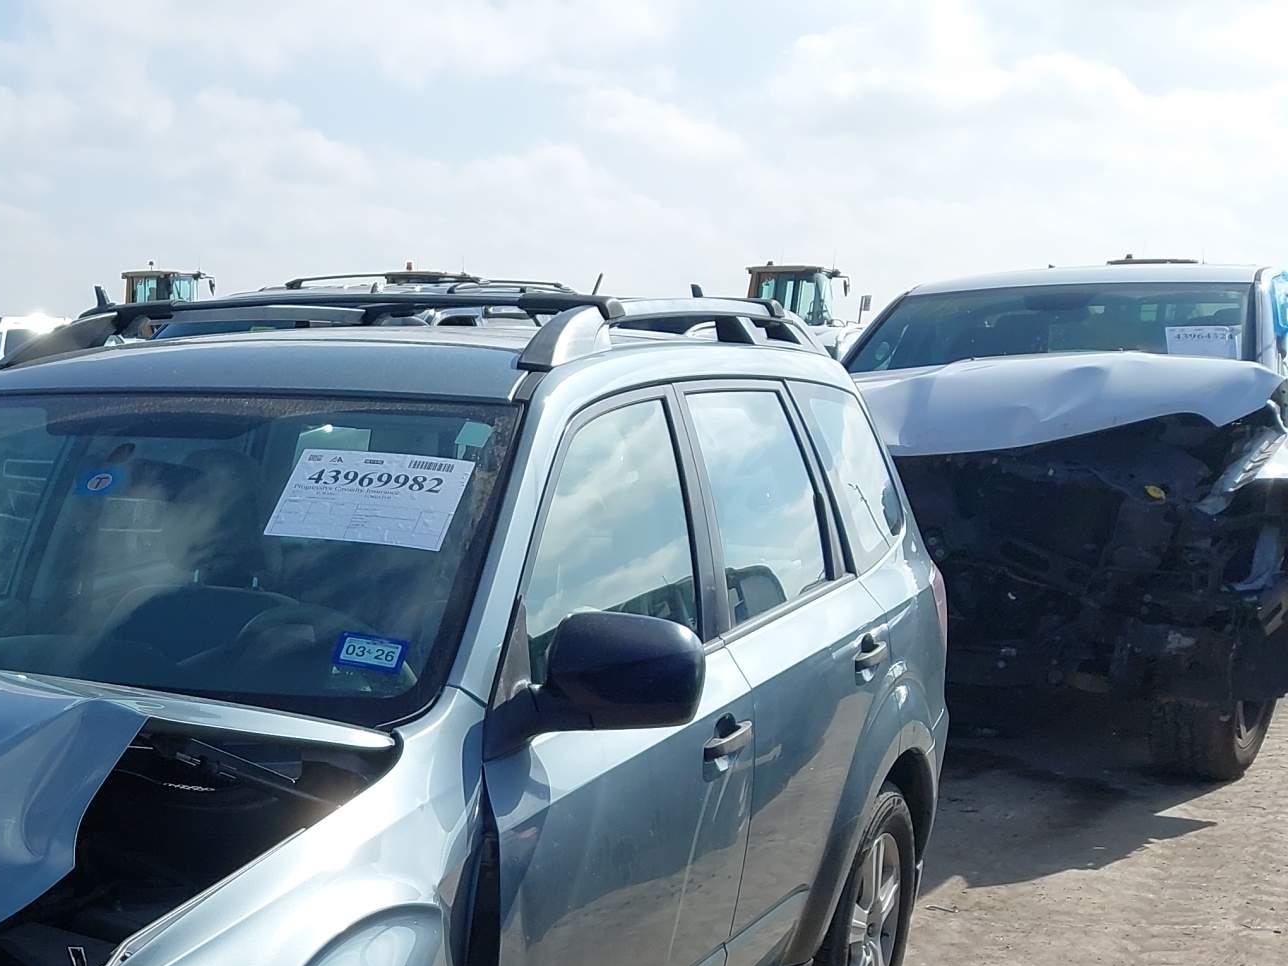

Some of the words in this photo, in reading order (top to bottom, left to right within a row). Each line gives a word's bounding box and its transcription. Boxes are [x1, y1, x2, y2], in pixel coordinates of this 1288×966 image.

[308, 468, 444, 494] 43969982
[346, 644, 367, 657] 03
[374, 648, 396, 662] 26
